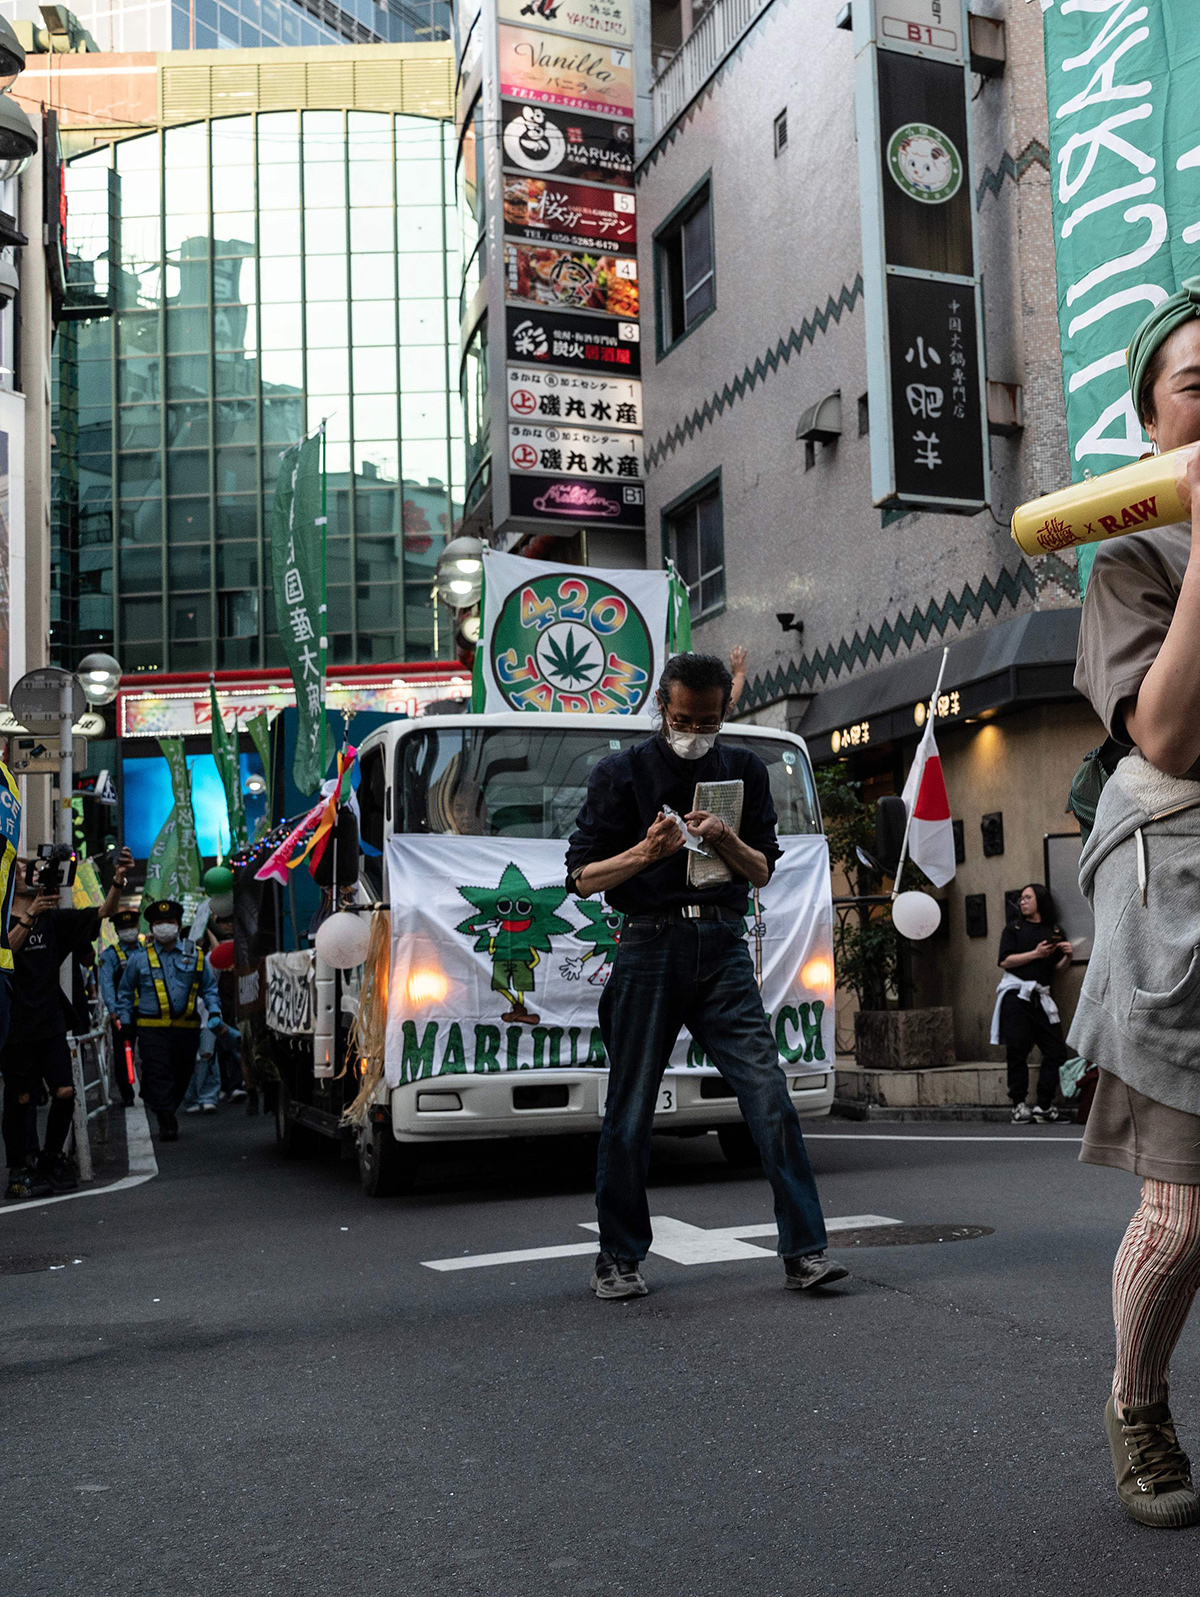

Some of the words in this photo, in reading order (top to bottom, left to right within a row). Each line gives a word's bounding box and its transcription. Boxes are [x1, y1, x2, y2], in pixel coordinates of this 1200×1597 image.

[908, 24, 932, 45] B1
[514, 41, 617, 83] Vanilla
[615, 51, 625, 66] 7
[616, 125, 629, 141] 6
[566, 143, 633, 165] HARUKA
[620, 196, 629, 211] 5
[537, 190, 634, 236] 桜ガーデン
[621, 264, 631, 277] 4
[512, 320, 549, 355] 彩
[624, 325, 634, 340] 3
[510, 371, 542, 384] さかな
[628, 384, 635, 398] 1
[538, 393, 638, 425] 磯丸水産
[511, 426, 543, 438] さかな
[629, 438, 636, 453] 1
[539, 448, 640, 478] 磯丸水産
[624, 488, 643, 502] B1
[1098, 495, 1159, 534] RAW
[519, 578, 629, 637] 420
[496, 648, 649, 716] JAPAN
